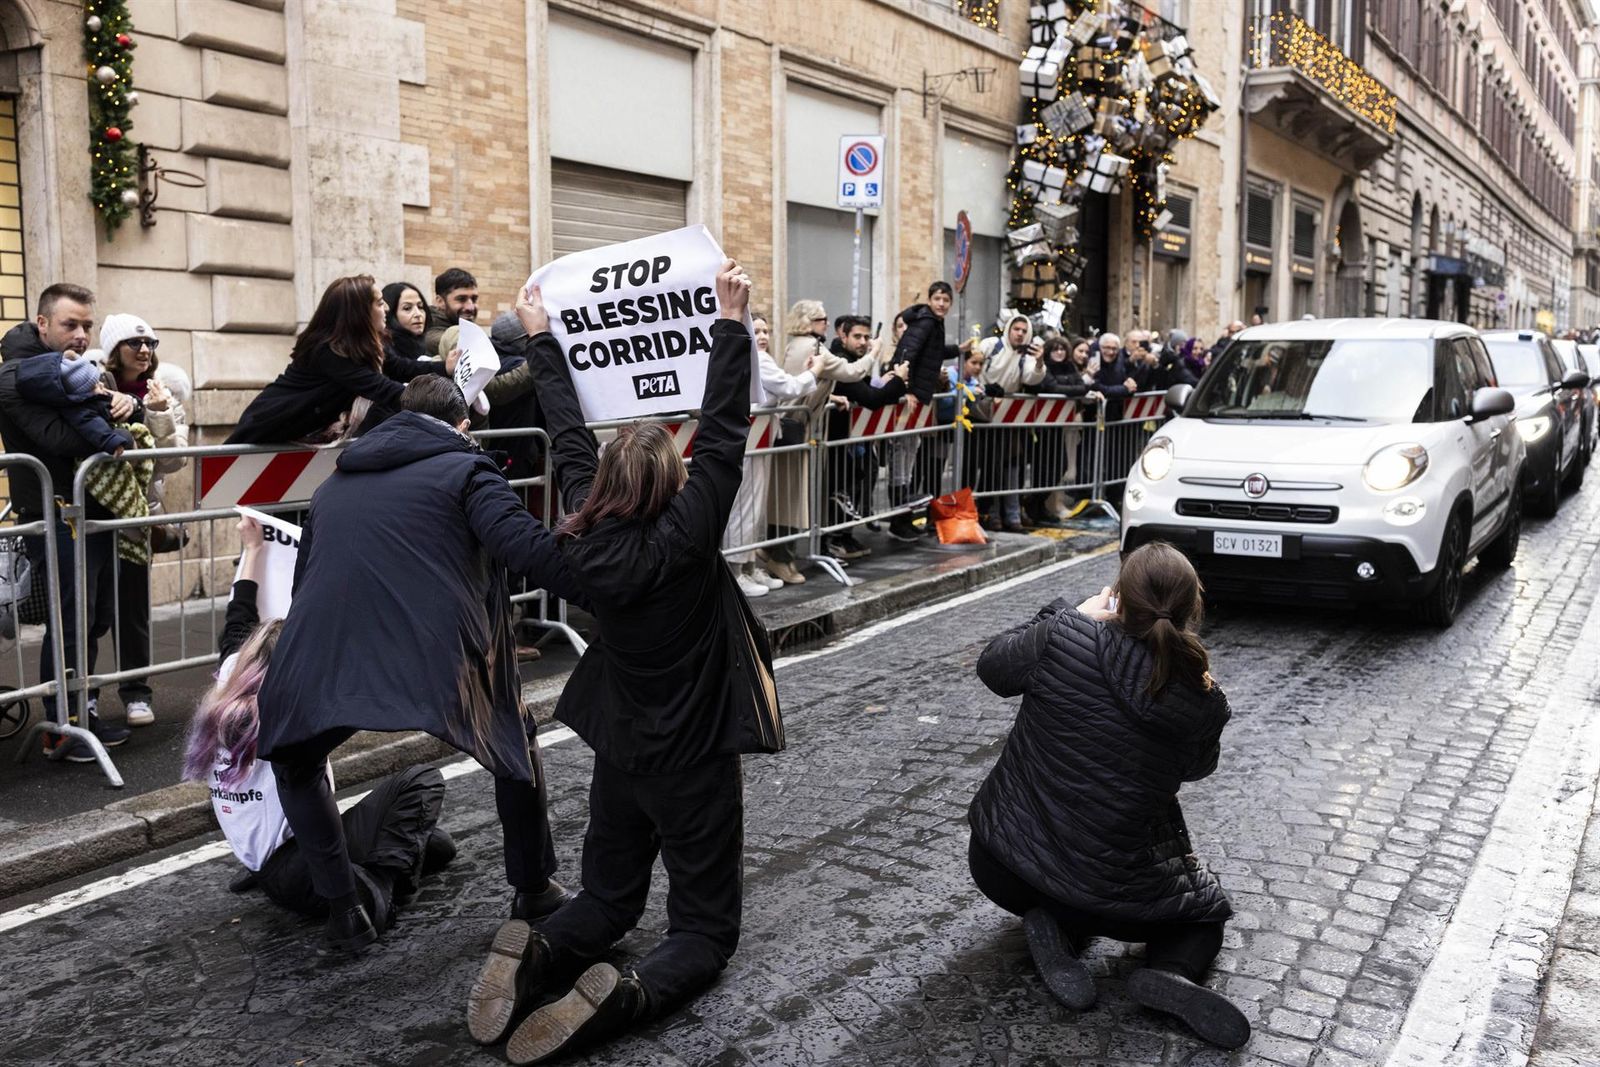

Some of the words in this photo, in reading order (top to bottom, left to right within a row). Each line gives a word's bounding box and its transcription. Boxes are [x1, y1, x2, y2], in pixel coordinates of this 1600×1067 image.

[590, 256, 671, 293] STOP
[560, 286, 717, 335] BLESSING
[568, 326, 715, 371] CORRIDA
[1215, 537, 1237, 550] SCV
[1242, 538, 1279, 553] 01321
